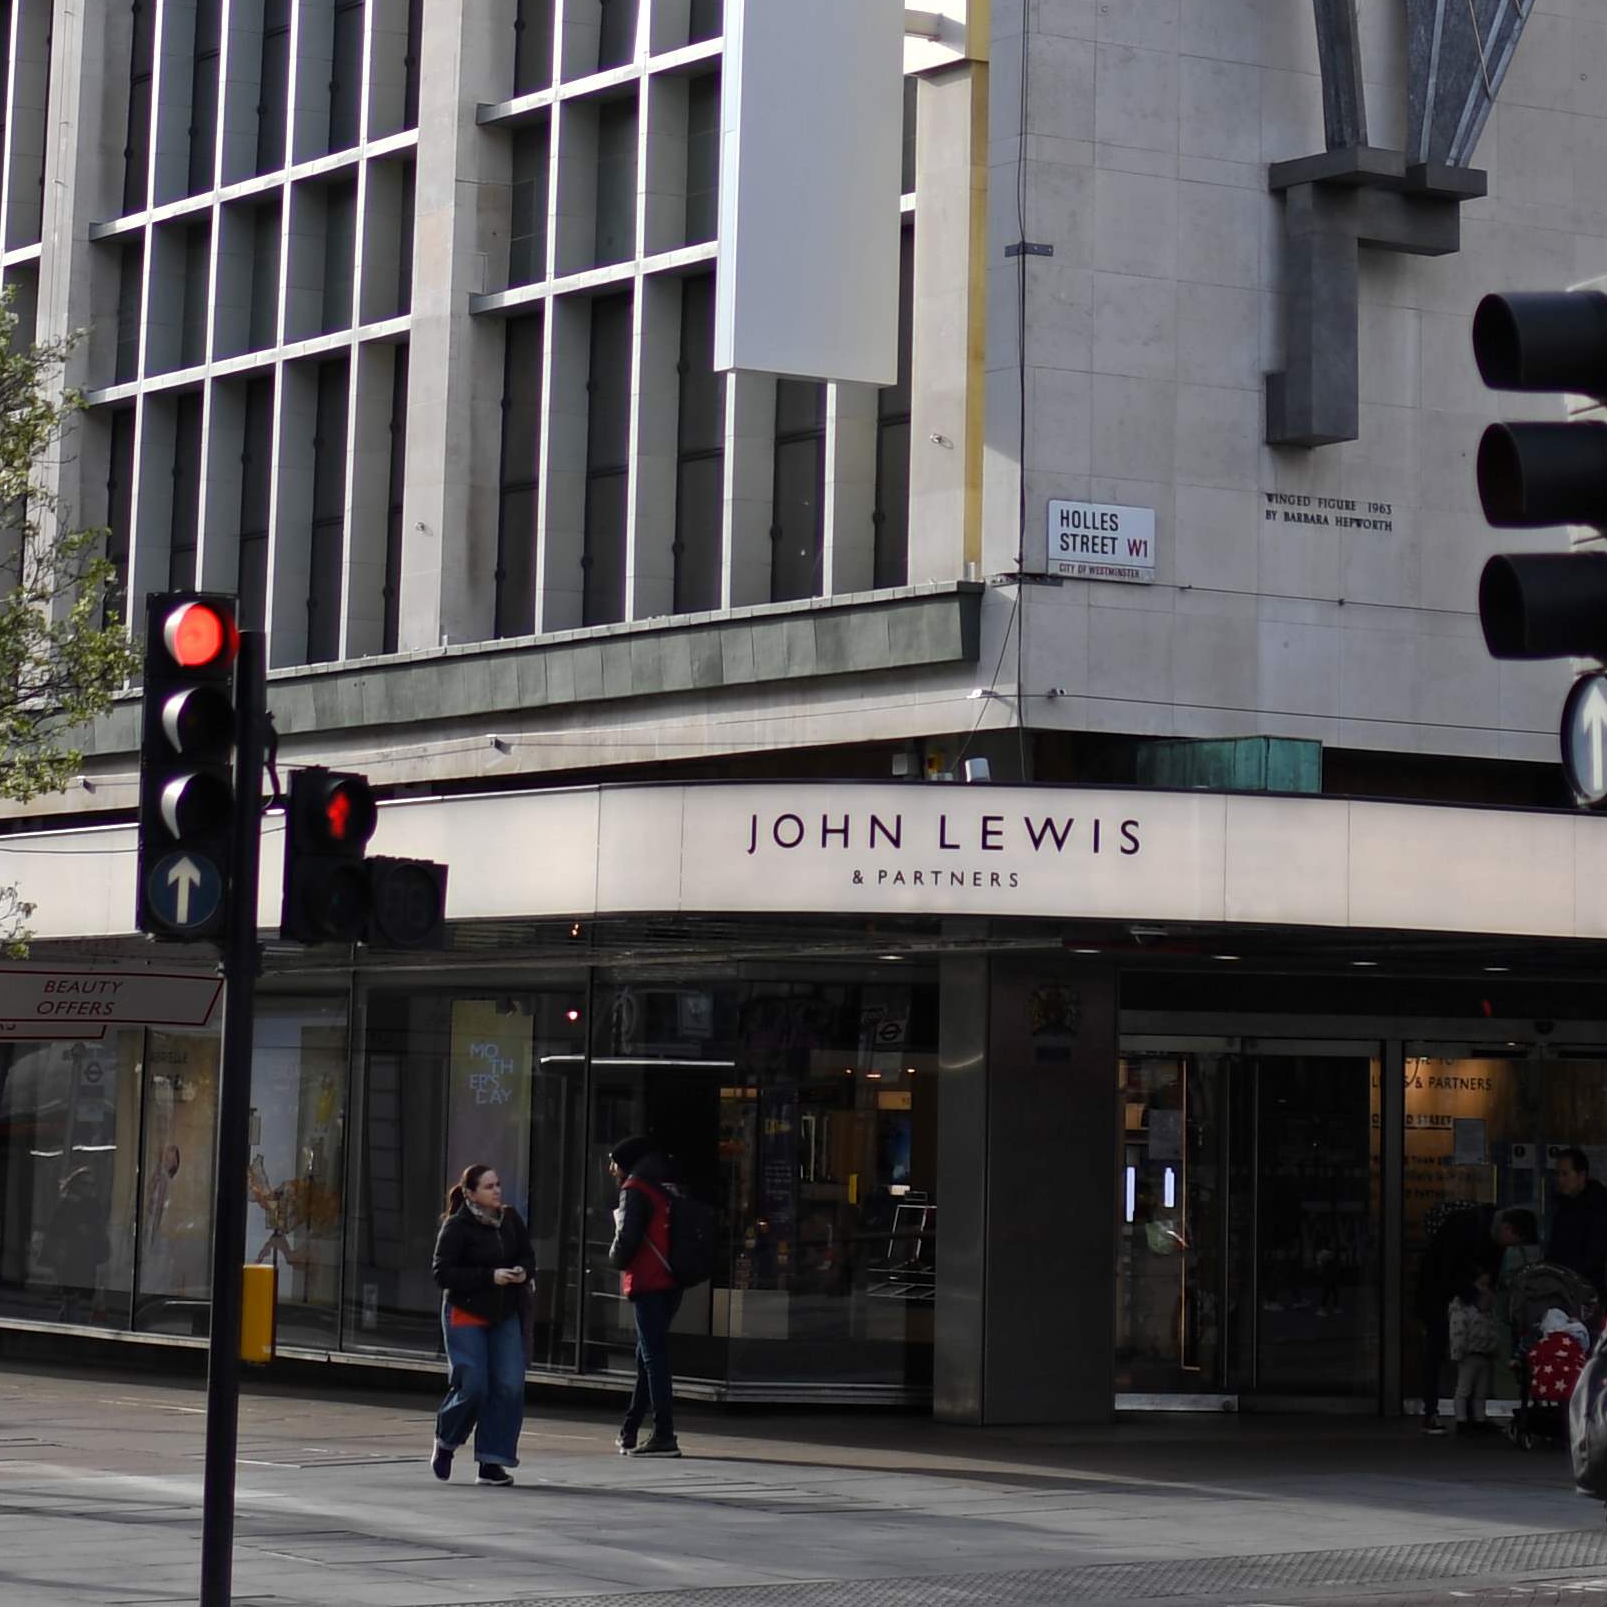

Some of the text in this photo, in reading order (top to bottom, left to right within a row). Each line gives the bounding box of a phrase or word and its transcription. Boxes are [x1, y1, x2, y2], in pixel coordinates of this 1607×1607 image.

[1265, 493, 1393, 515] WINGED FIGURE 1963
[1059, 508, 1119, 532] HOLLES
[1265, 510, 1393, 532] BY BARBARA HEPWORTH
[1059, 532, 1149, 558] STREET W1
[1059, 562, 1140, 578] CITY OF WESTMINSTER
[747, 813, 1141, 856] JOHN LEWIS
[851, 869, 1019, 888] & PARTNERS
[44, 979, 124, 995] BEAUTY
[36, 1000, 116, 1017] OFFERS
[1415, 1077, 1423, 1089] &
[1428, 1076, 1493, 1091] PARTNERS
[1417, 1114, 1453, 1126] STREET
